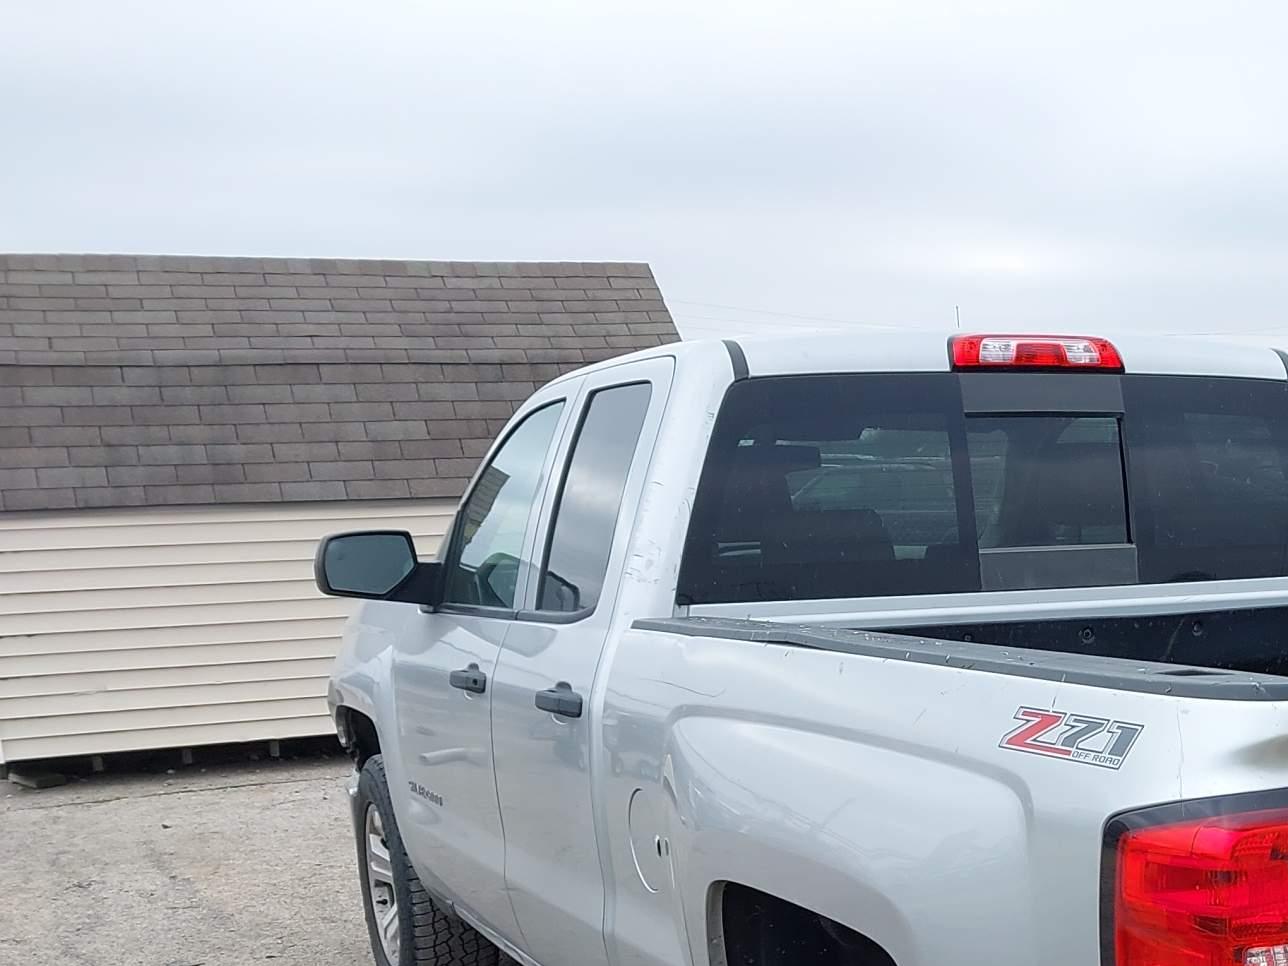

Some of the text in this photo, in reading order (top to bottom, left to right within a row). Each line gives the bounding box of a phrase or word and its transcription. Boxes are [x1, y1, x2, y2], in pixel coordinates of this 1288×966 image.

[1000, 706, 1143, 764] Z71
[1072, 751, 1121, 766] OFF ROAD
